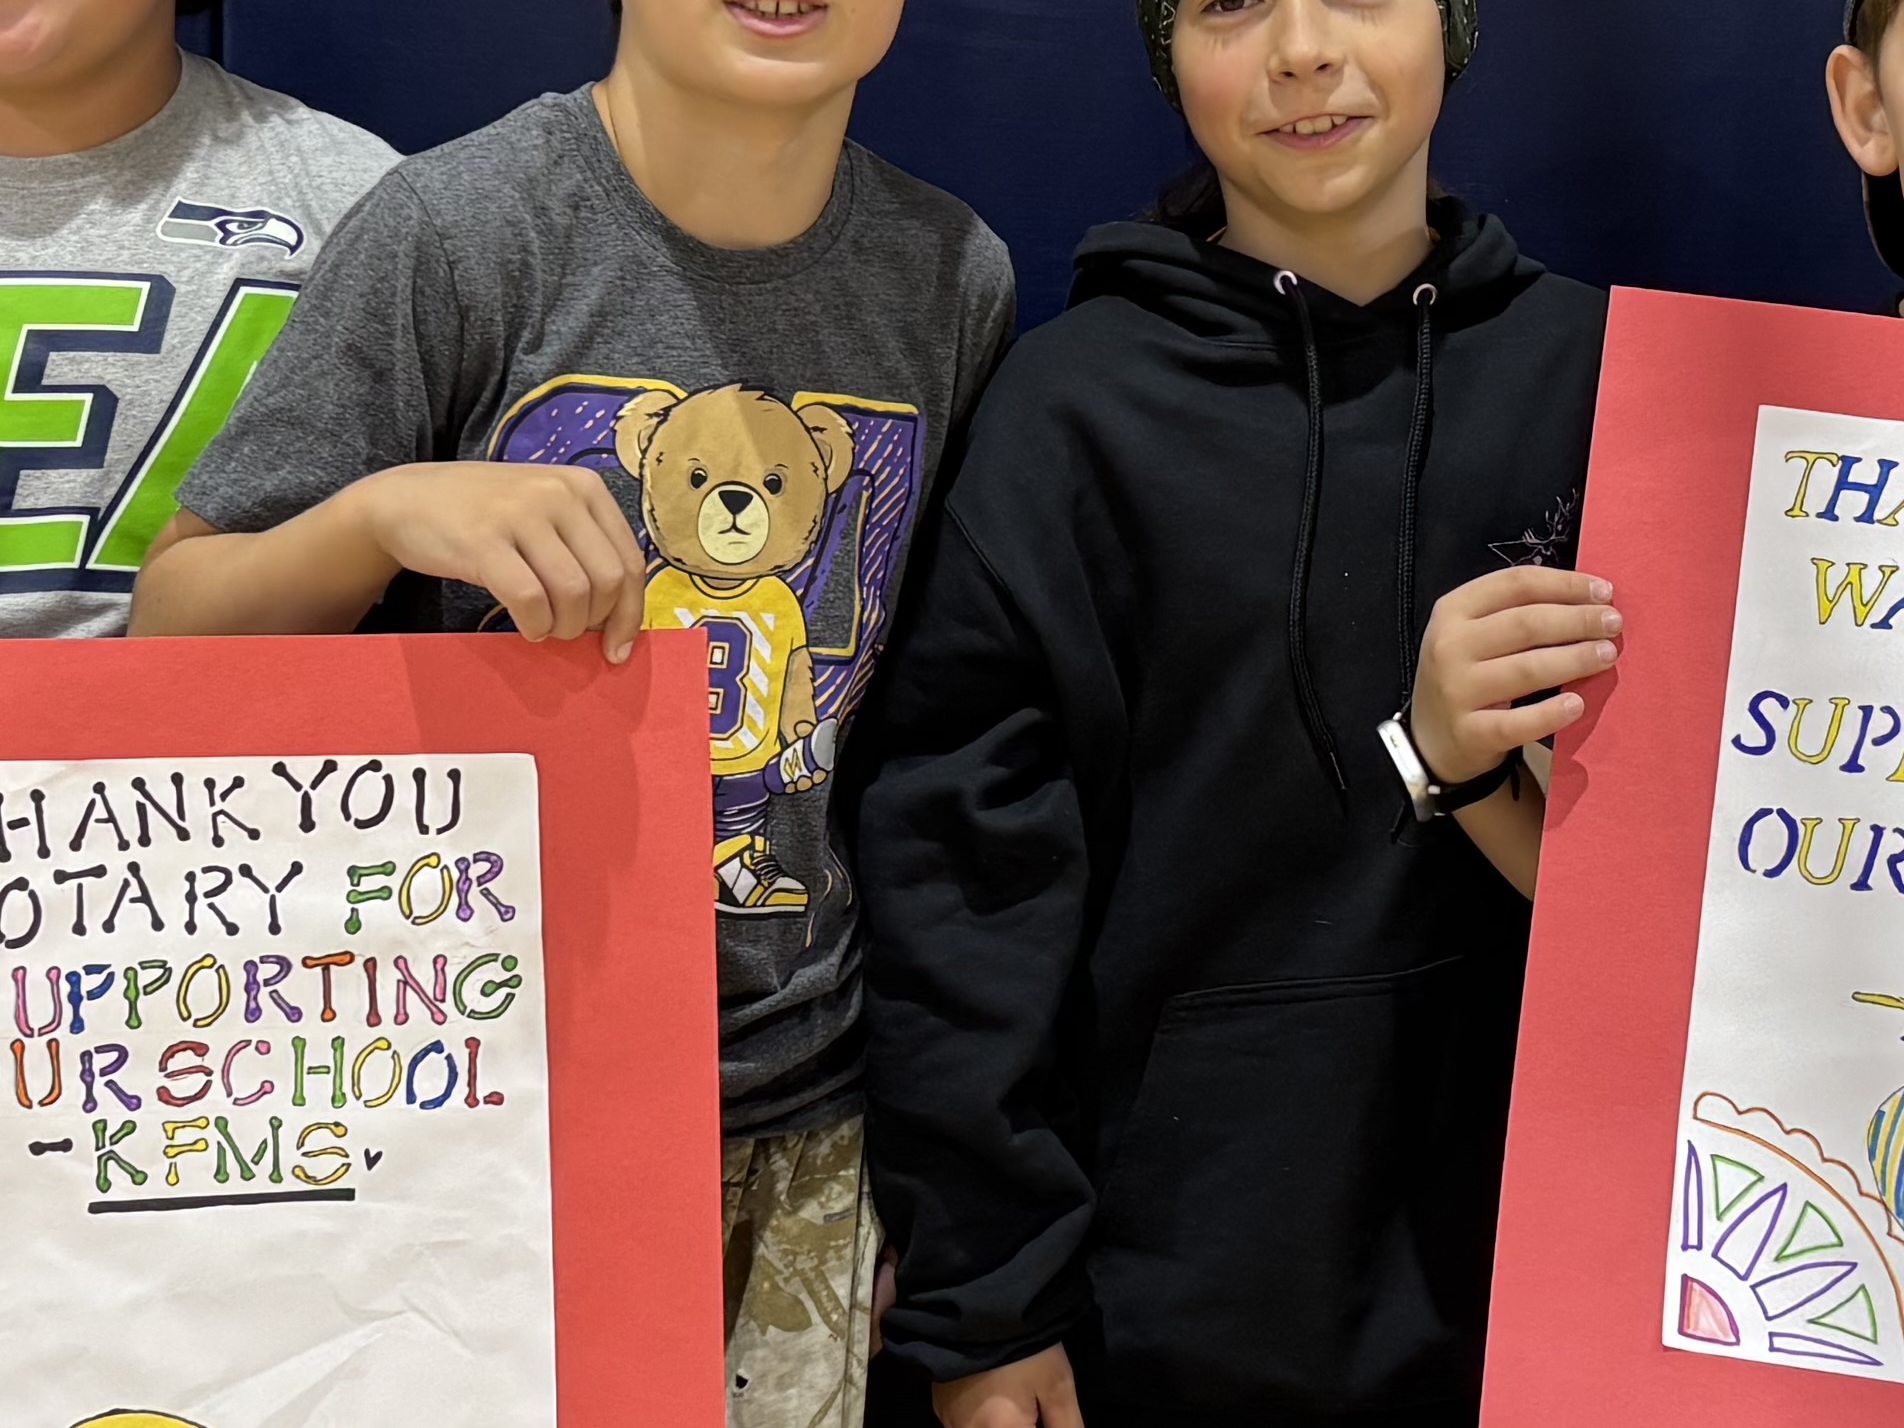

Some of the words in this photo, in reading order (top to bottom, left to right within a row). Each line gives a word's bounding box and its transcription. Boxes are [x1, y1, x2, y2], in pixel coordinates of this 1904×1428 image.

[272, 758, 462, 835] YOU
[344, 851, 517, 935] FOR
[156, 1035, 505, 1109] SCHOOL
